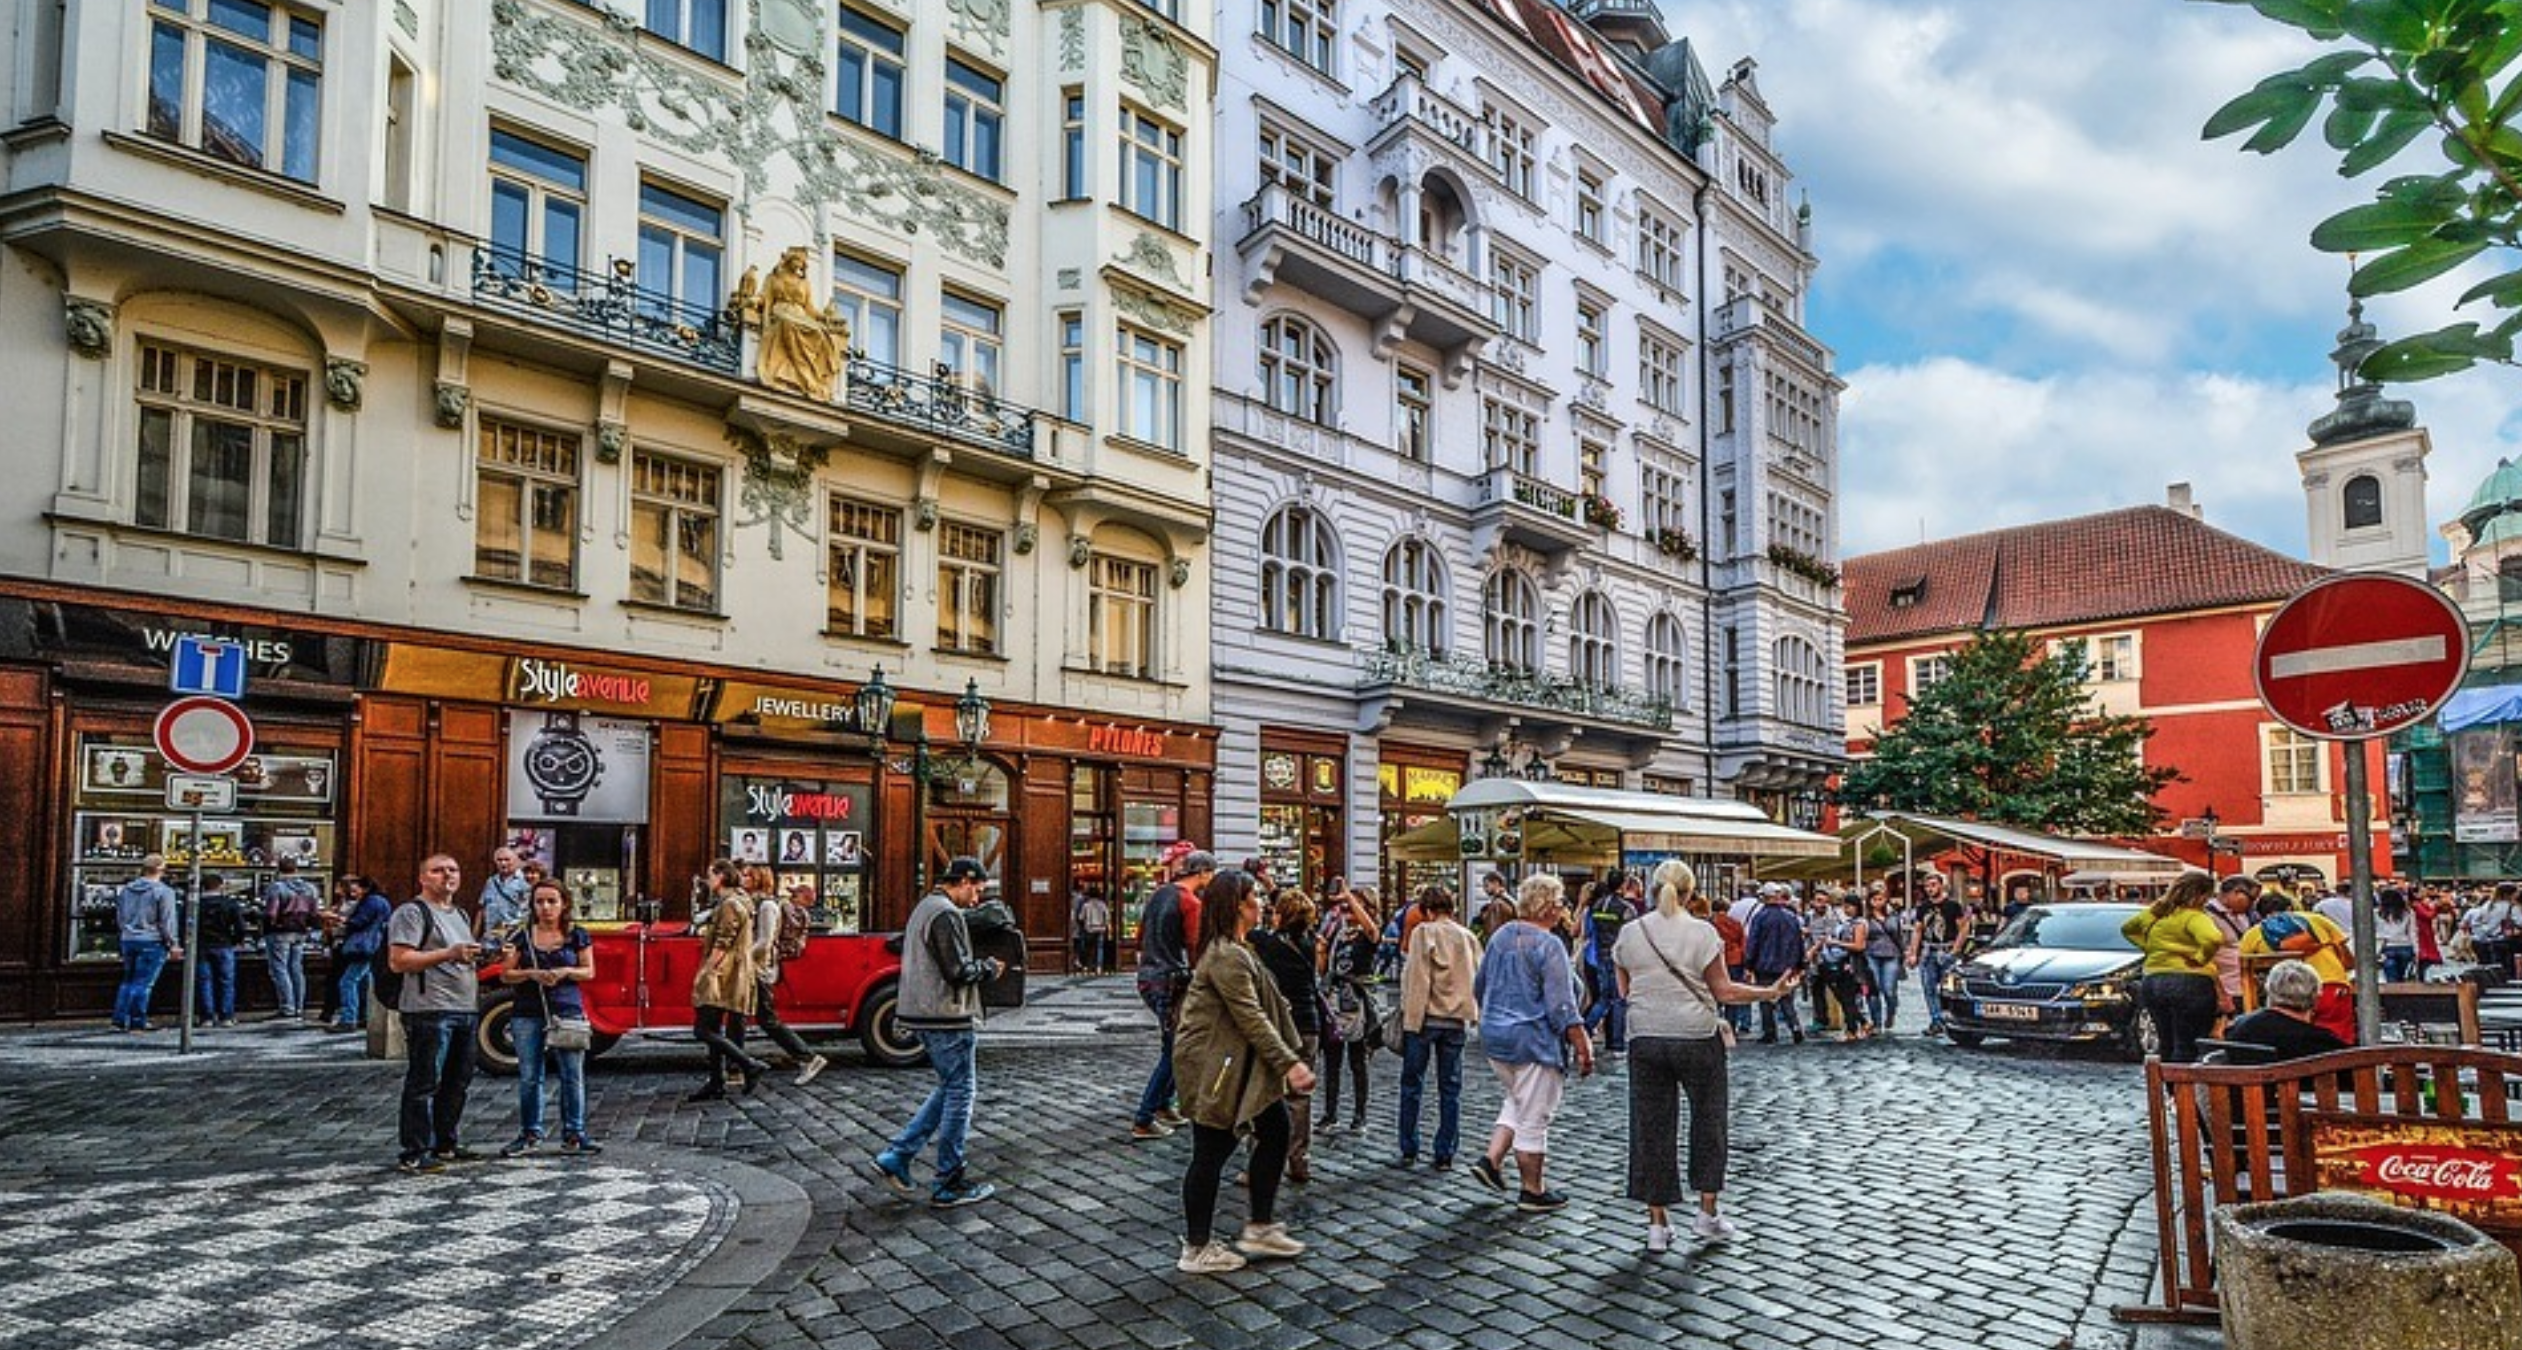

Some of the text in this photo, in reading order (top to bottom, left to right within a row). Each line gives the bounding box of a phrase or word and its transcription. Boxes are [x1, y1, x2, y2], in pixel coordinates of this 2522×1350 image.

[754, 696, 854, 722] JEWELLERY
[1088, 726, 1163, 756] PYLONES
[2378, 1155, 2495, 1189] Coca-Cola
